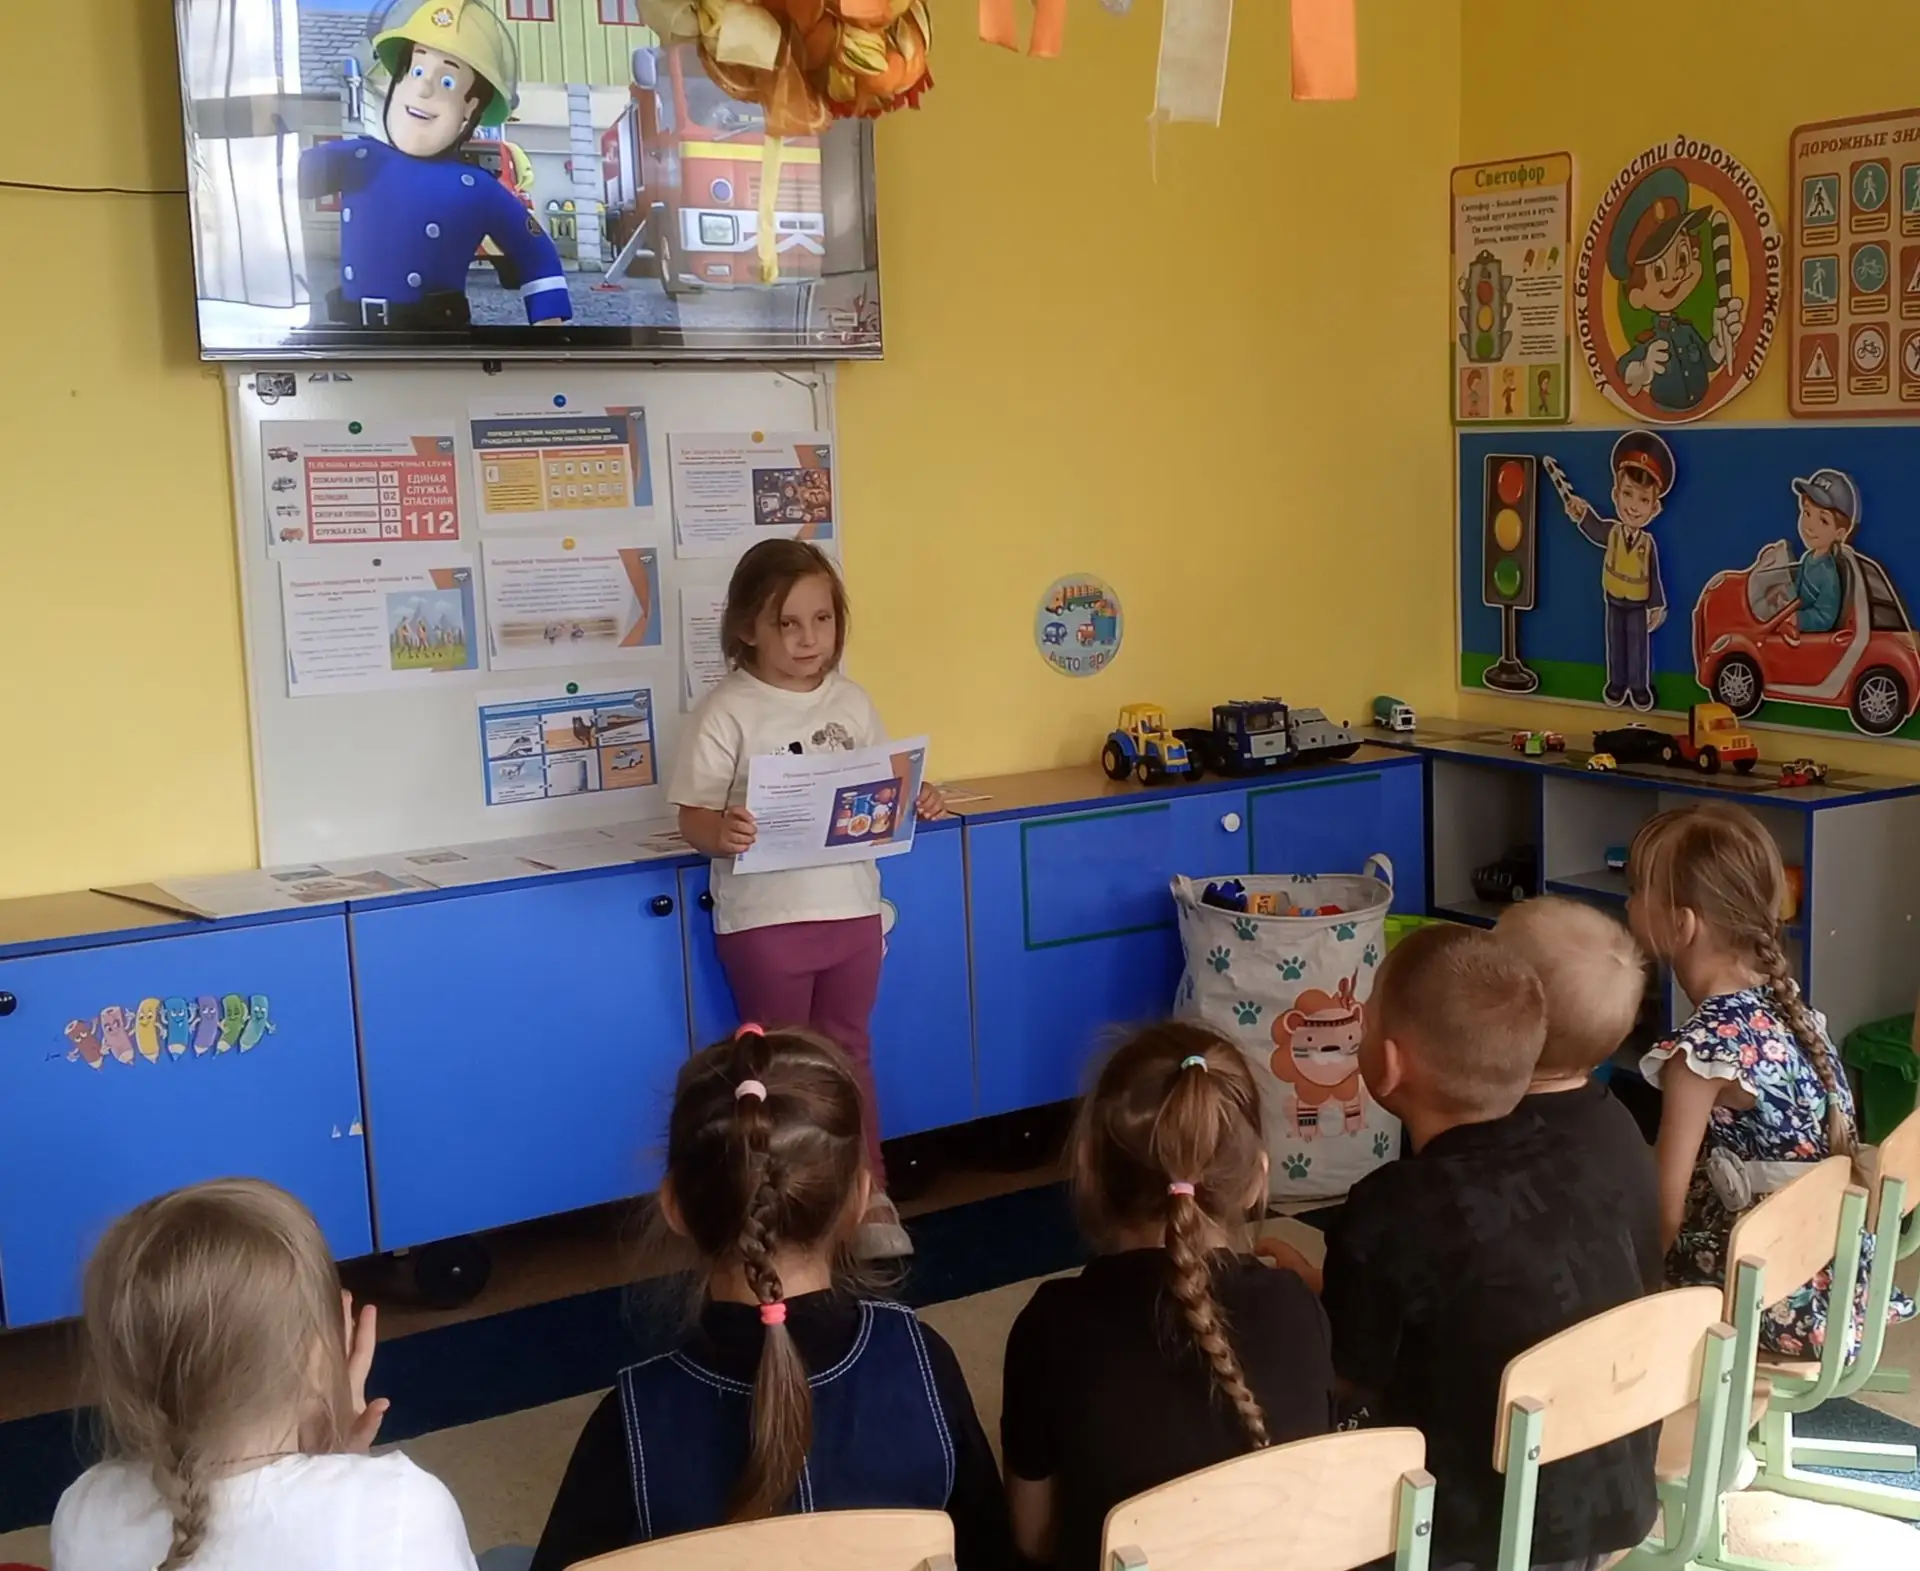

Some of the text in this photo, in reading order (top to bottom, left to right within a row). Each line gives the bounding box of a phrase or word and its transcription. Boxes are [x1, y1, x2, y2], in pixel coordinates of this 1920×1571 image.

[1798, 132, 1889, 159] ДОРОЖНЫЕ
[1475, 165, 1545, 188] Светофор
[1574, 142, 1669, 300] безопасности
[1673, 134, 1771, 230] дорожного
[1743, 232, 1783, 382] движения
[382, 474, 394, 484] 01
[407, 474, 447, 485] ЕДИНАЯ
[406, 484, 449, 495] СЛУЖБА
[383, 491, 397, 501] 02
[403, 496, 454, 506] СПАСЕНИЯ
[384, 508, 397, 518] 03
[405, 510, 455, 535] 112
[385, 525, 398, 535] 04
